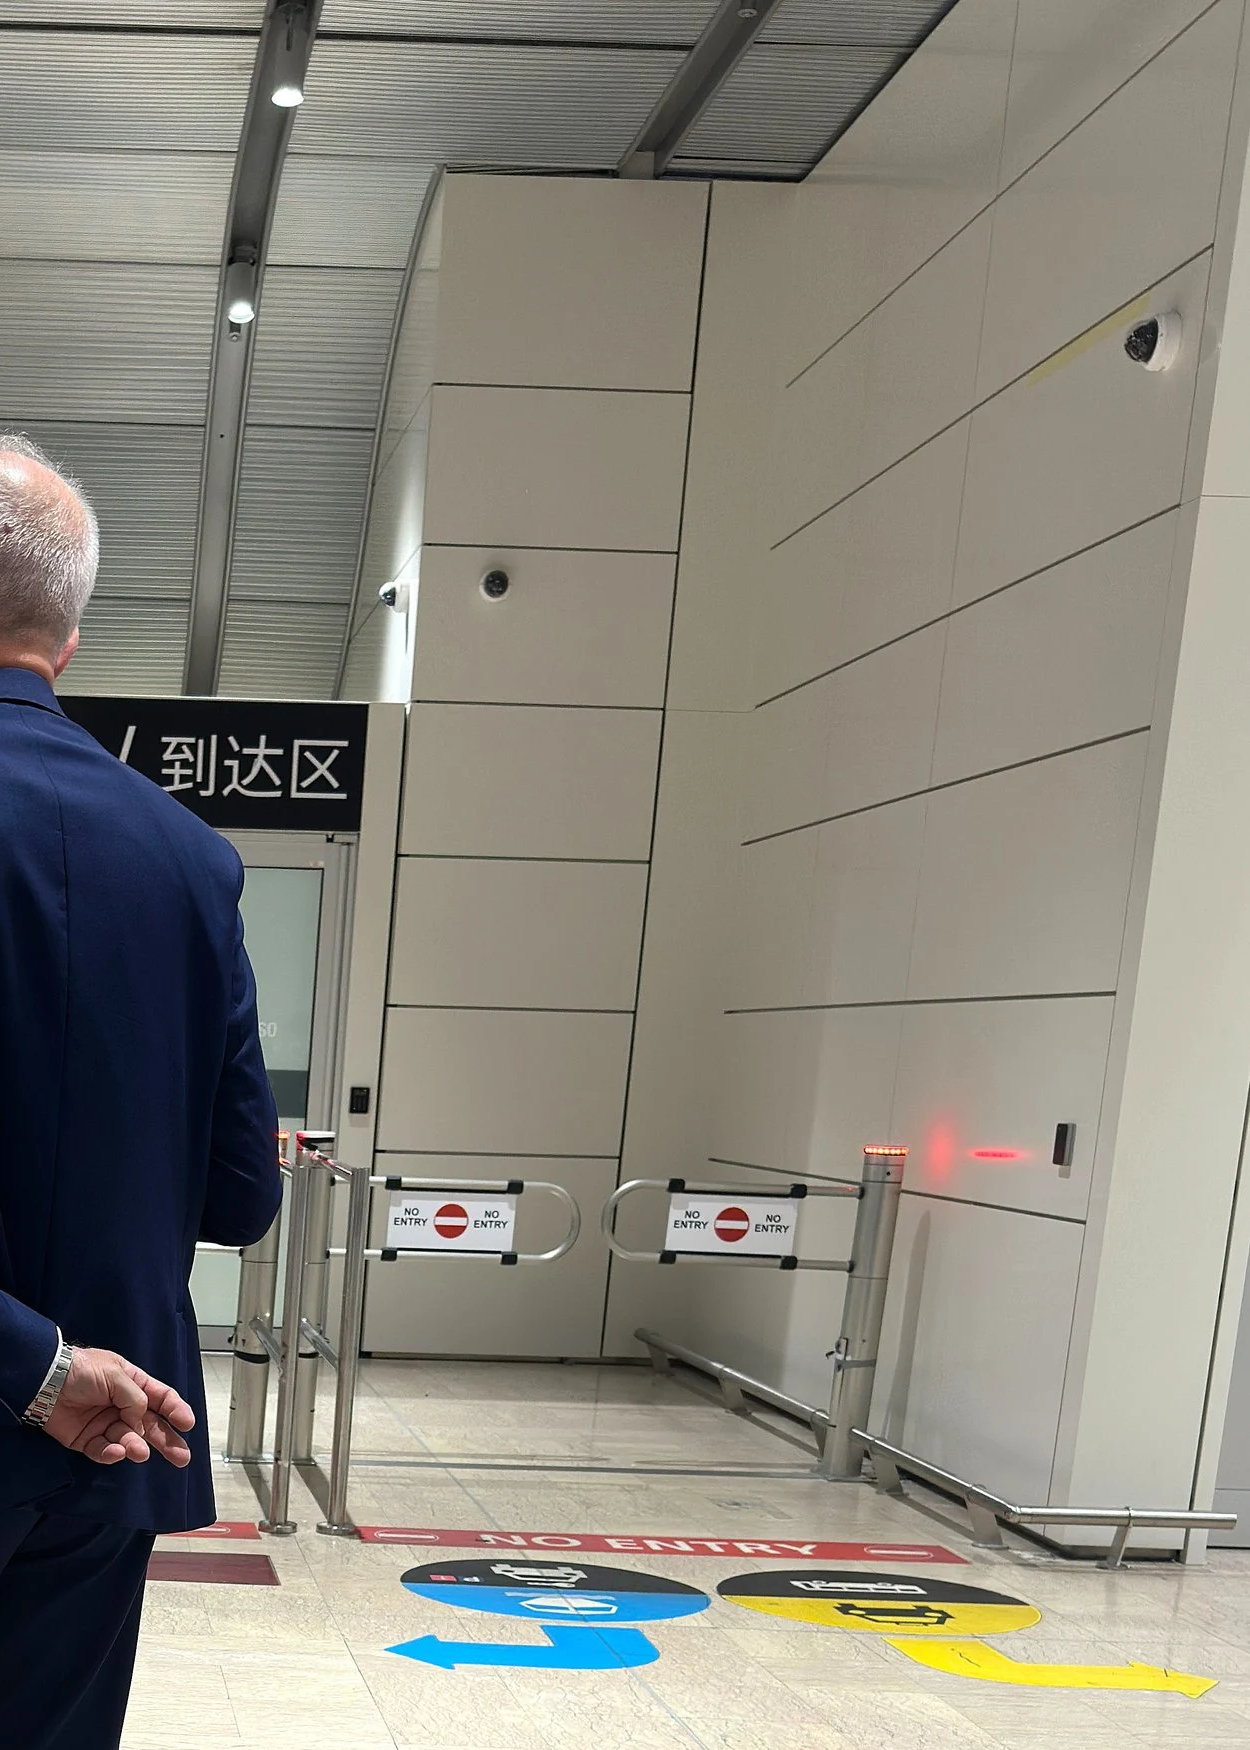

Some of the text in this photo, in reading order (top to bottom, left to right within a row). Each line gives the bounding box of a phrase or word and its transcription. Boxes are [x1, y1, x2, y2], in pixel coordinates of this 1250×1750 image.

[161, 734, 349, 800] 到达区
[404, 1207, 419, 1216] NO
[484, 1210, 500, 1219] NO
[684, 1210, 700, 1219] NO
[393, 1217, 428, 1227] ENTRY
[765, 1214, 781, 1224] NO
[473, 1220, 508, 1229] ENTRY
[673, 1219, 709, 1230] ENTRY
[754, 1223, 789, 1234] ENTRY
[477, 1532, 817, 1556] NO ENTRY
